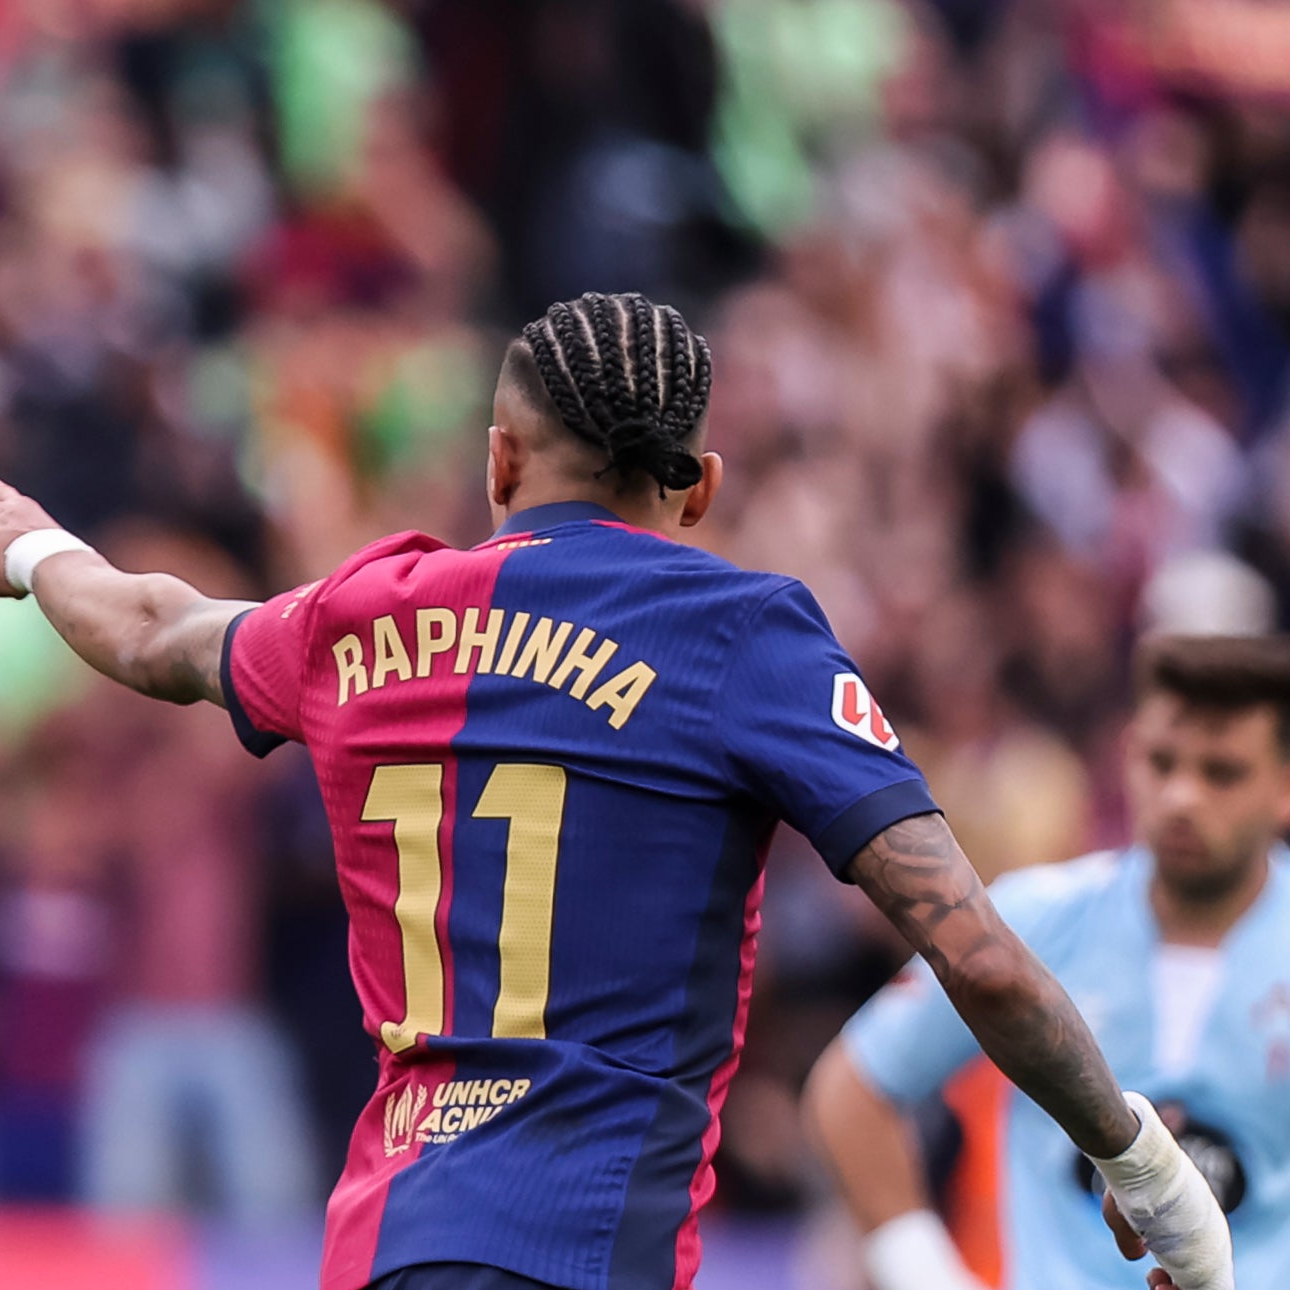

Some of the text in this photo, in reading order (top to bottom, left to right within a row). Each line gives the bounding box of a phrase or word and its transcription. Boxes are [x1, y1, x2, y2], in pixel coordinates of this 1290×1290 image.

[331, 607, 657, 730] RAPHINHA
[360, 763, 568, 1054] 11
[432, 1078, 531, 1107] UNHCR
